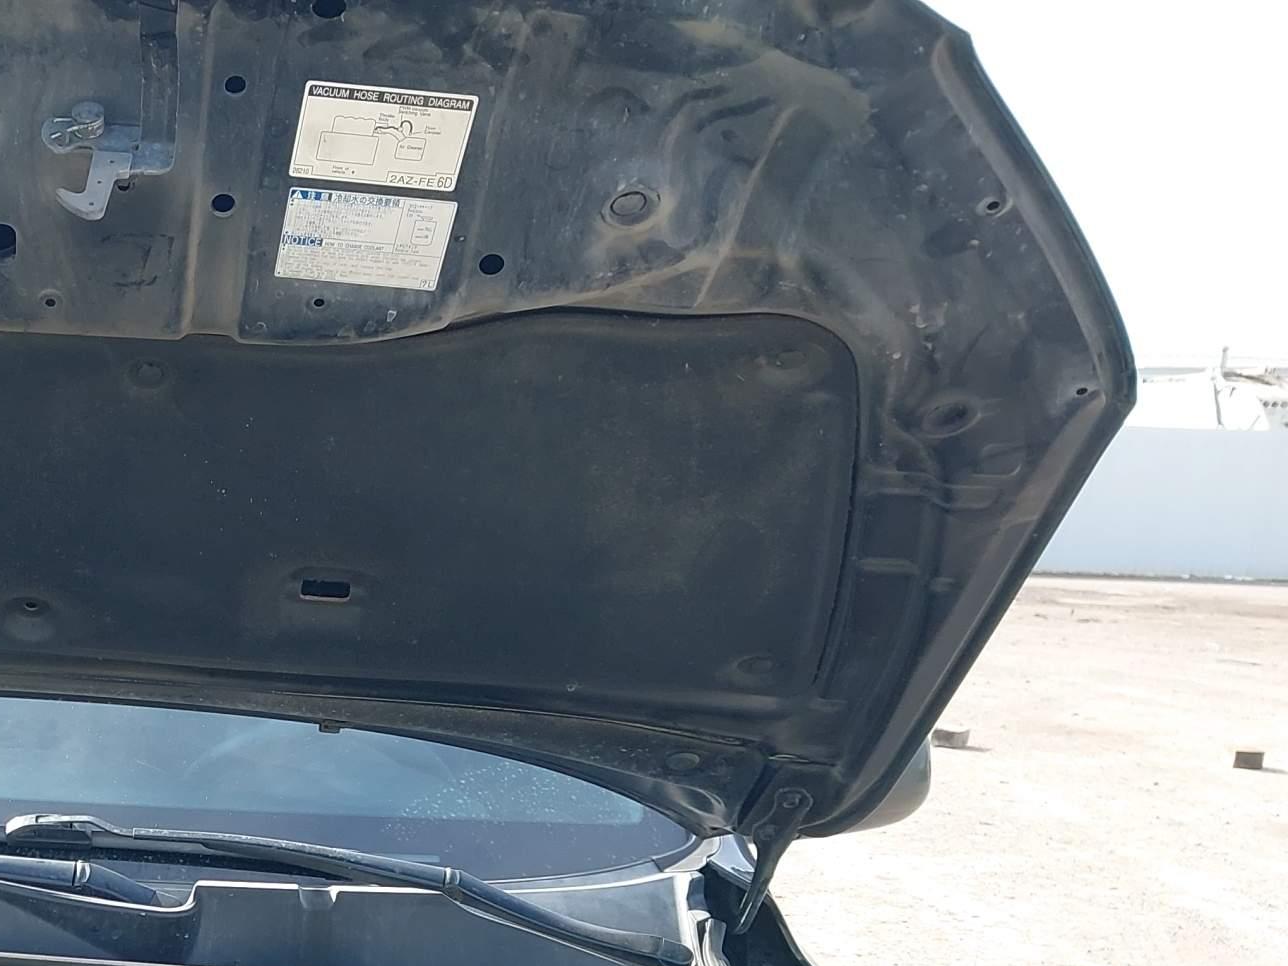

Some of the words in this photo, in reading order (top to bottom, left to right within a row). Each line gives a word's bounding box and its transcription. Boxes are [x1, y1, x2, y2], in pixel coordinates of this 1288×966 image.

[312, 86, 350, 98] VACUUM
[354, 91, 380, 101] HOSE
[383, 93, 424, 105] ROUTING
[428, 98, 470, 110] DIAGRAM
[389, 174, 435, 187] 2AZ-FE
[436, 176, 452, 189] 6D
[282, 235, 321, 246] NOTICE
